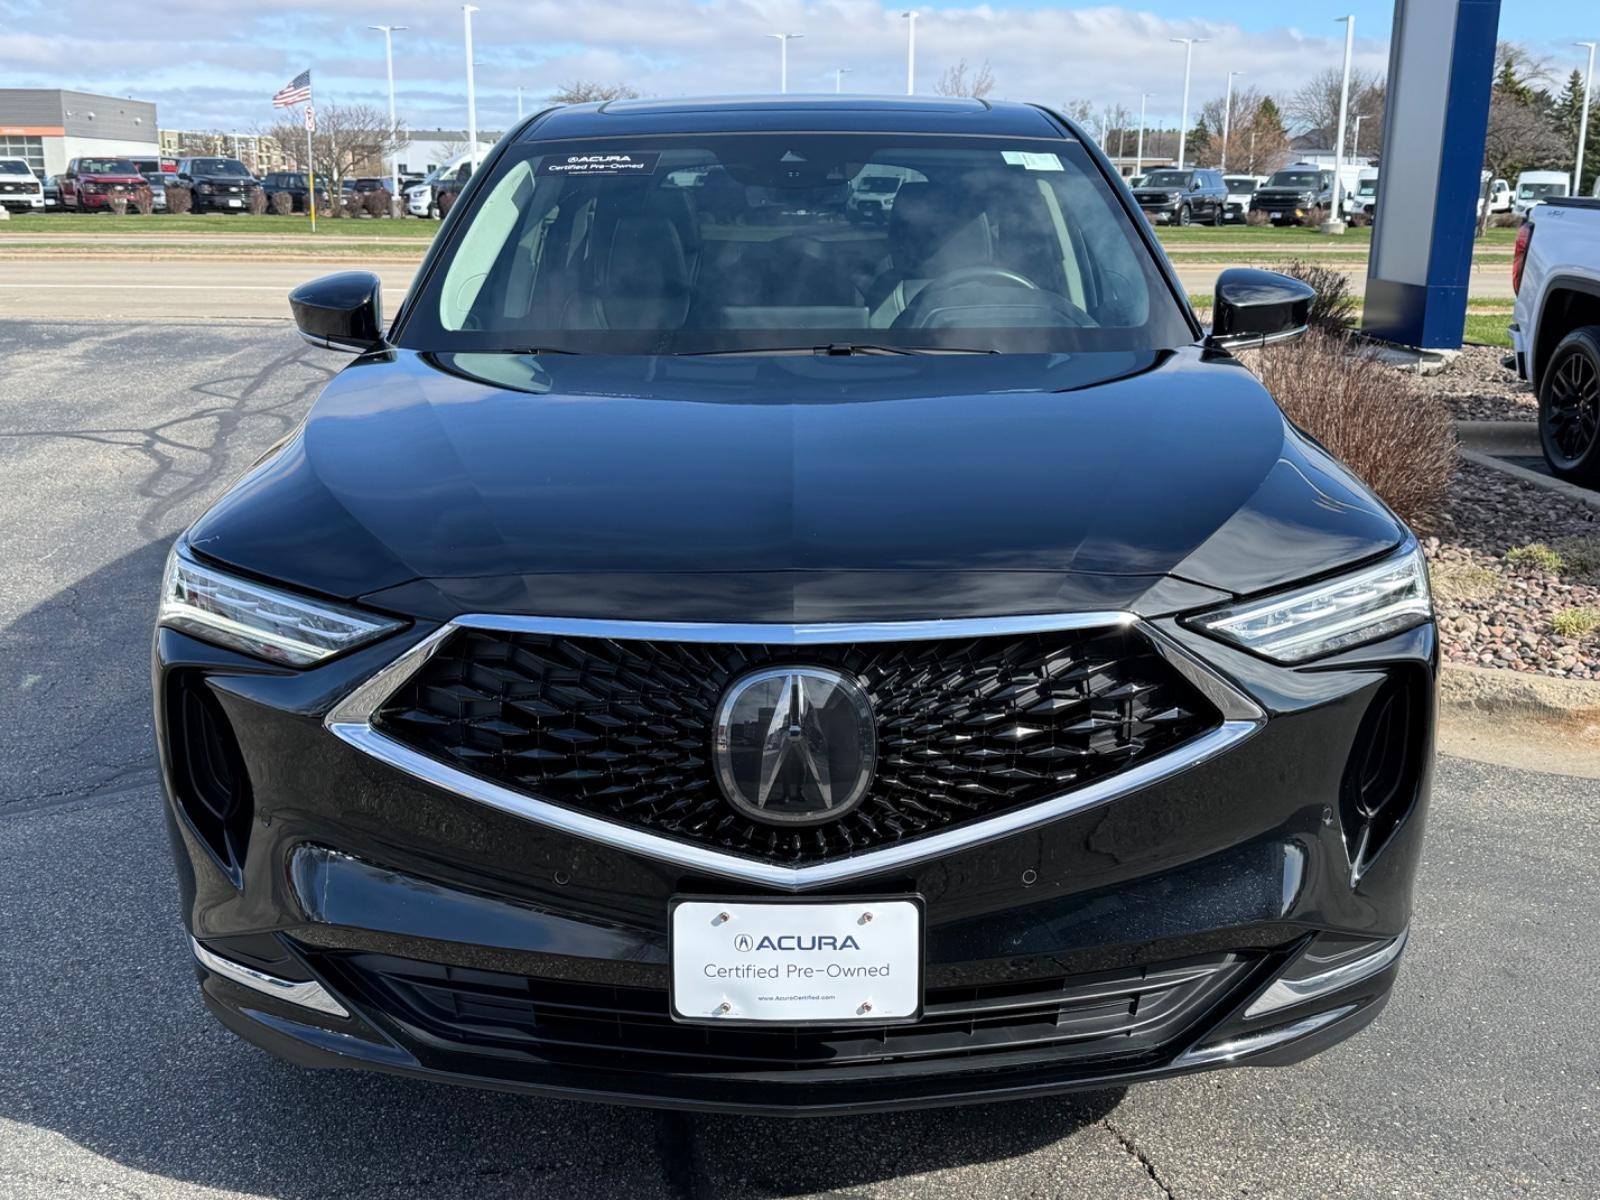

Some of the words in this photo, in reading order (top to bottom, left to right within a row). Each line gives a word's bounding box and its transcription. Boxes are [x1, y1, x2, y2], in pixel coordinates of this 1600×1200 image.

[577, 155, 631, 163] ACURA
[756, 935, 860, 951] ACURA
[704, 964, 779, 979] Certified
[786, 963, 890, 979] Pre-Owned
